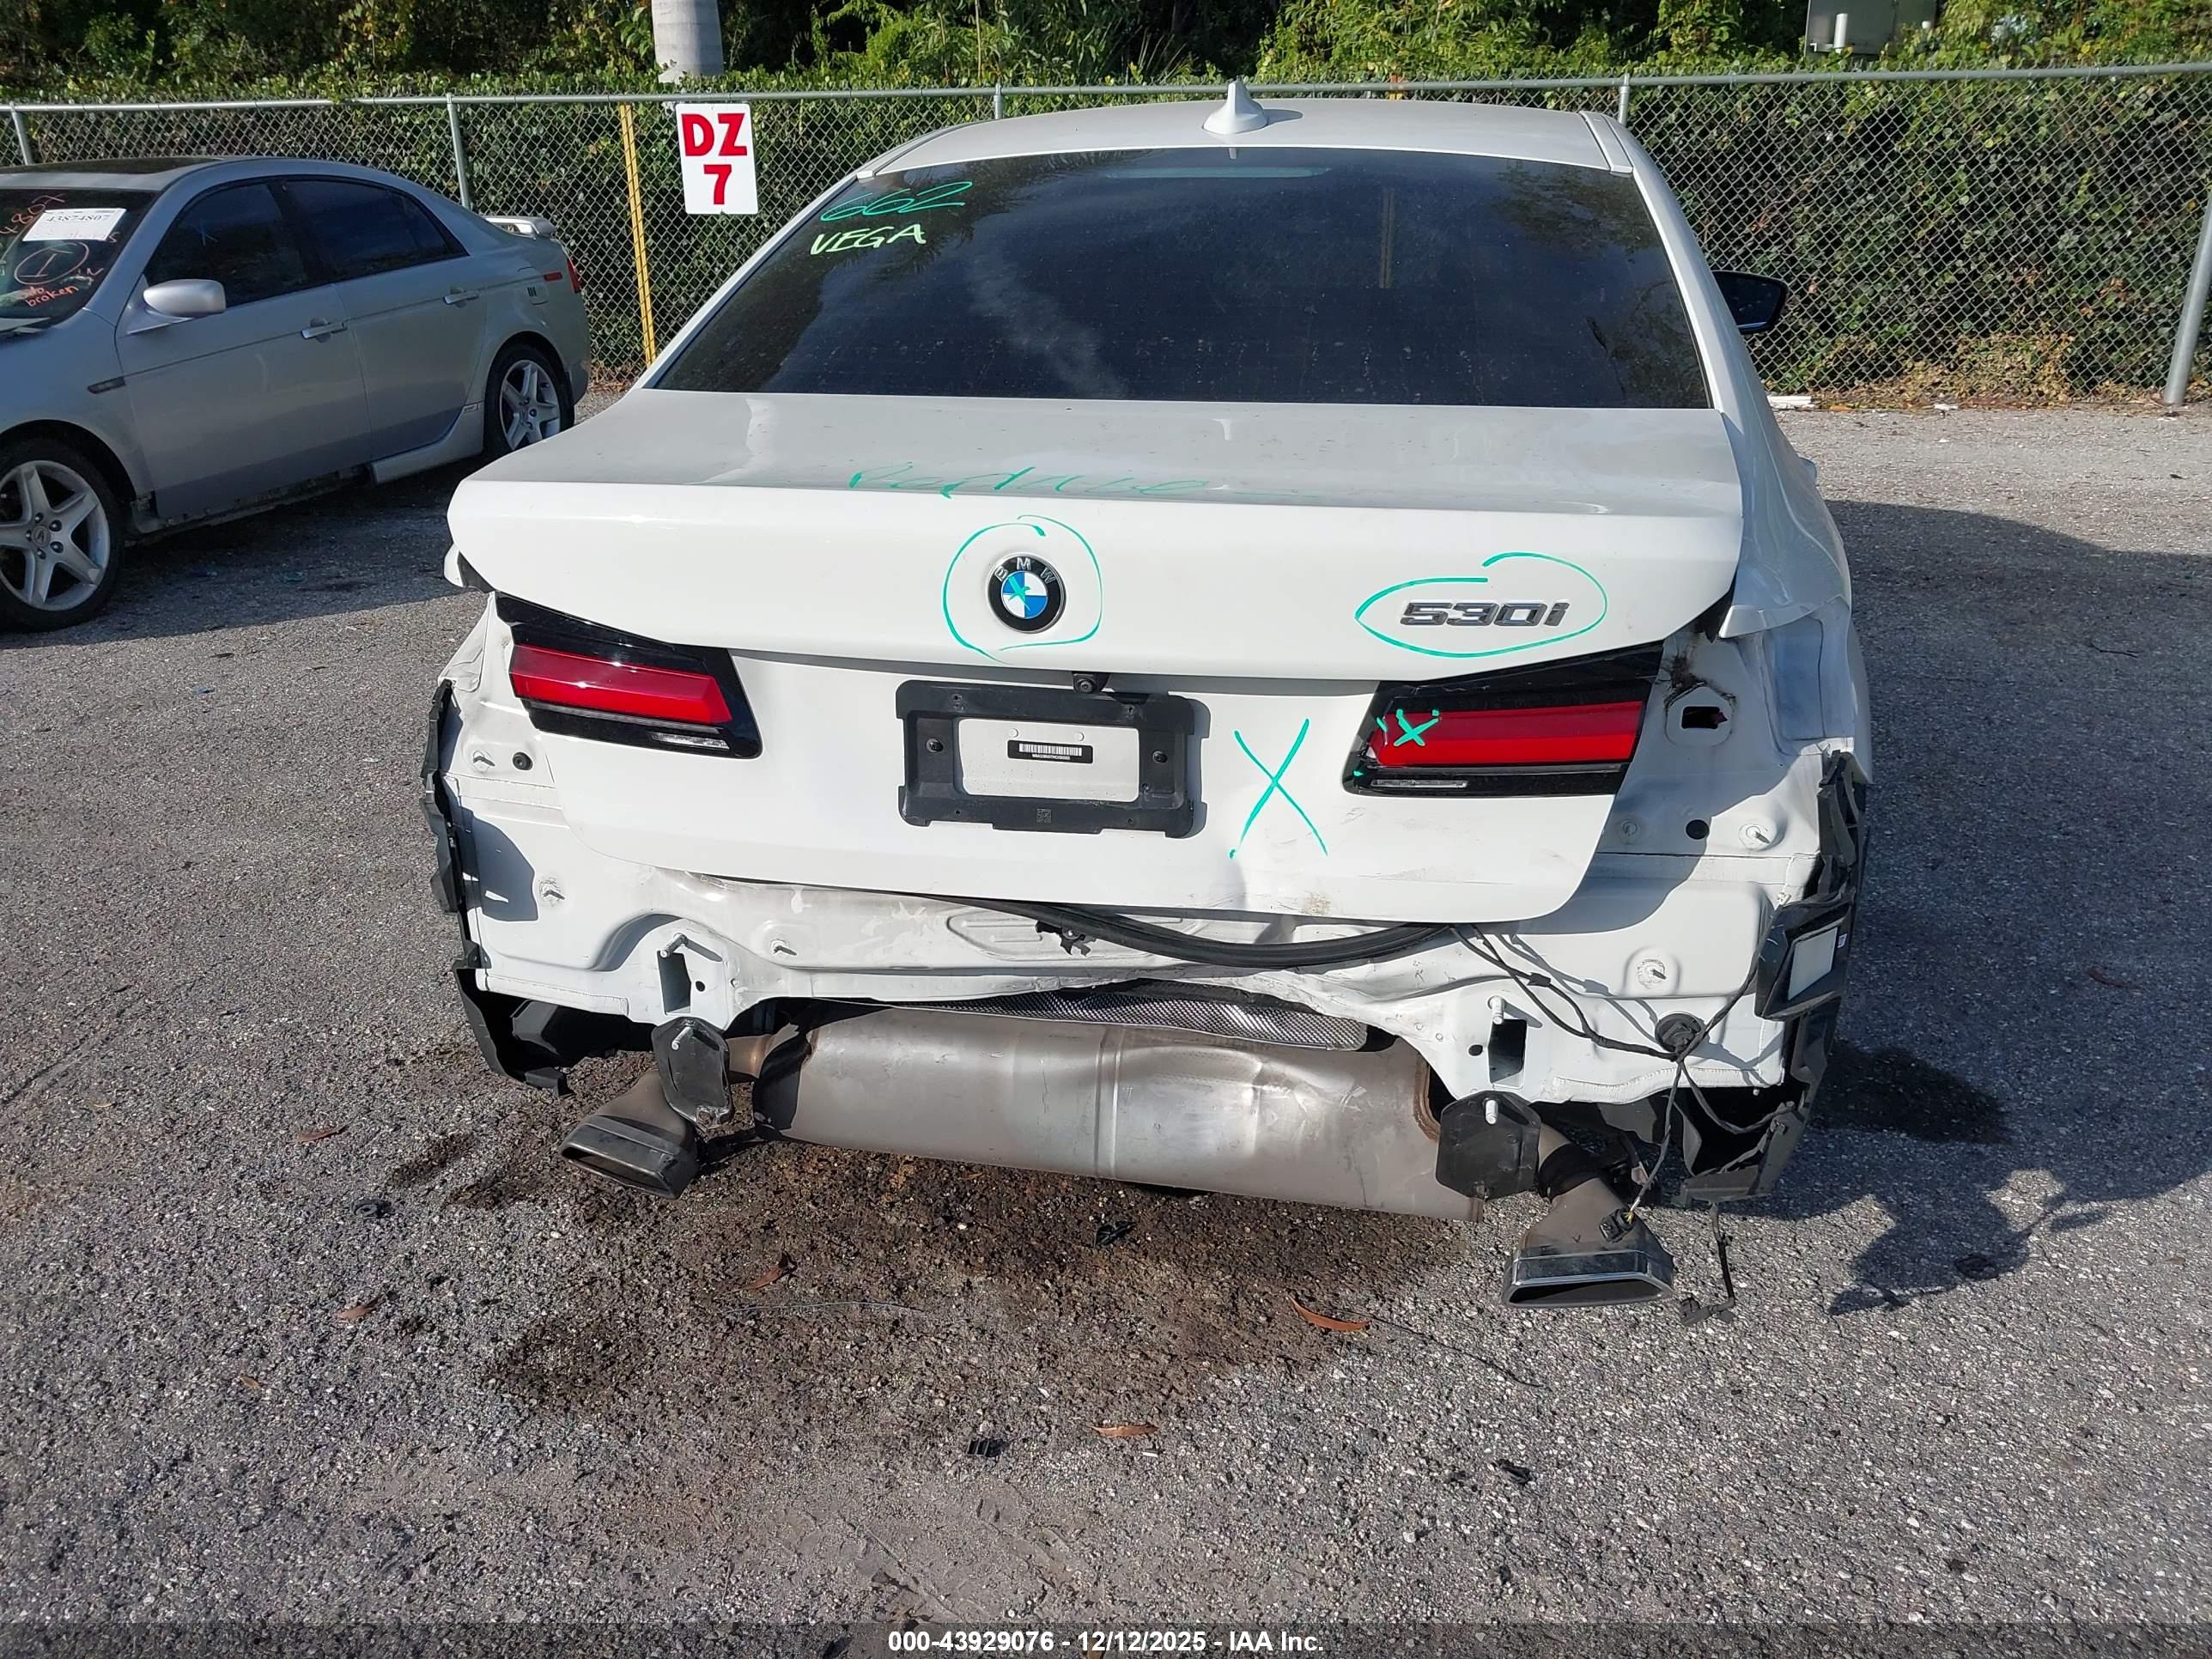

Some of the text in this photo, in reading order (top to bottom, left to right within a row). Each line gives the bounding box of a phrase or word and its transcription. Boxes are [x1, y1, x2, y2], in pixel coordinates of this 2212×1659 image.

[682, 113, 748, 156] DZ
[704, 164, 732, 205] 7
[810, 224, 927, 255] VEGA
[994, 556, 1056, 584] BMW
[1400, 601, 1571, 626] 530i
